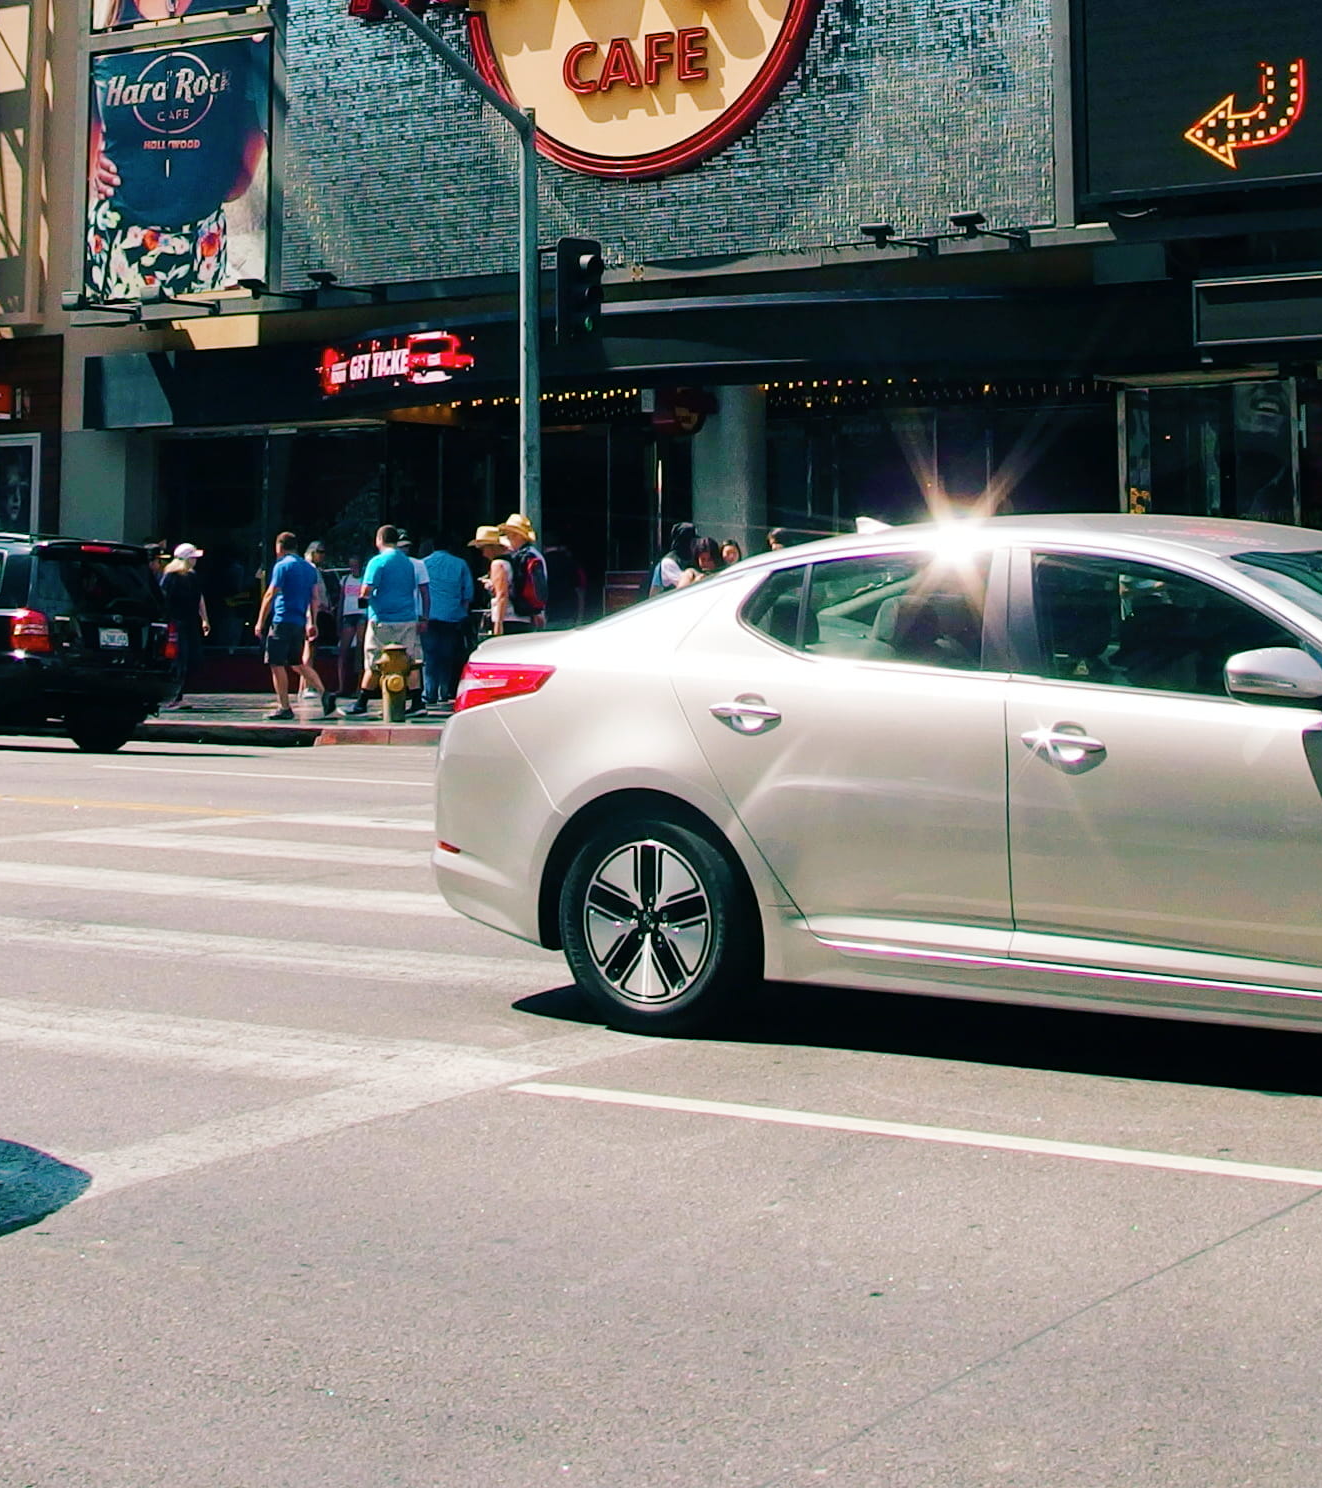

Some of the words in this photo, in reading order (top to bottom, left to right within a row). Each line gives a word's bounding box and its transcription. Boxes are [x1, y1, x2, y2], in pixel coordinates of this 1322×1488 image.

[562, 26, 710, 95] CAFE
[105, 70, 173, 107] Hard
[174, 67, 233, 104] Rock
[156, 108, 190, 122] CAFE
[349, 353, 372, 381] GET
